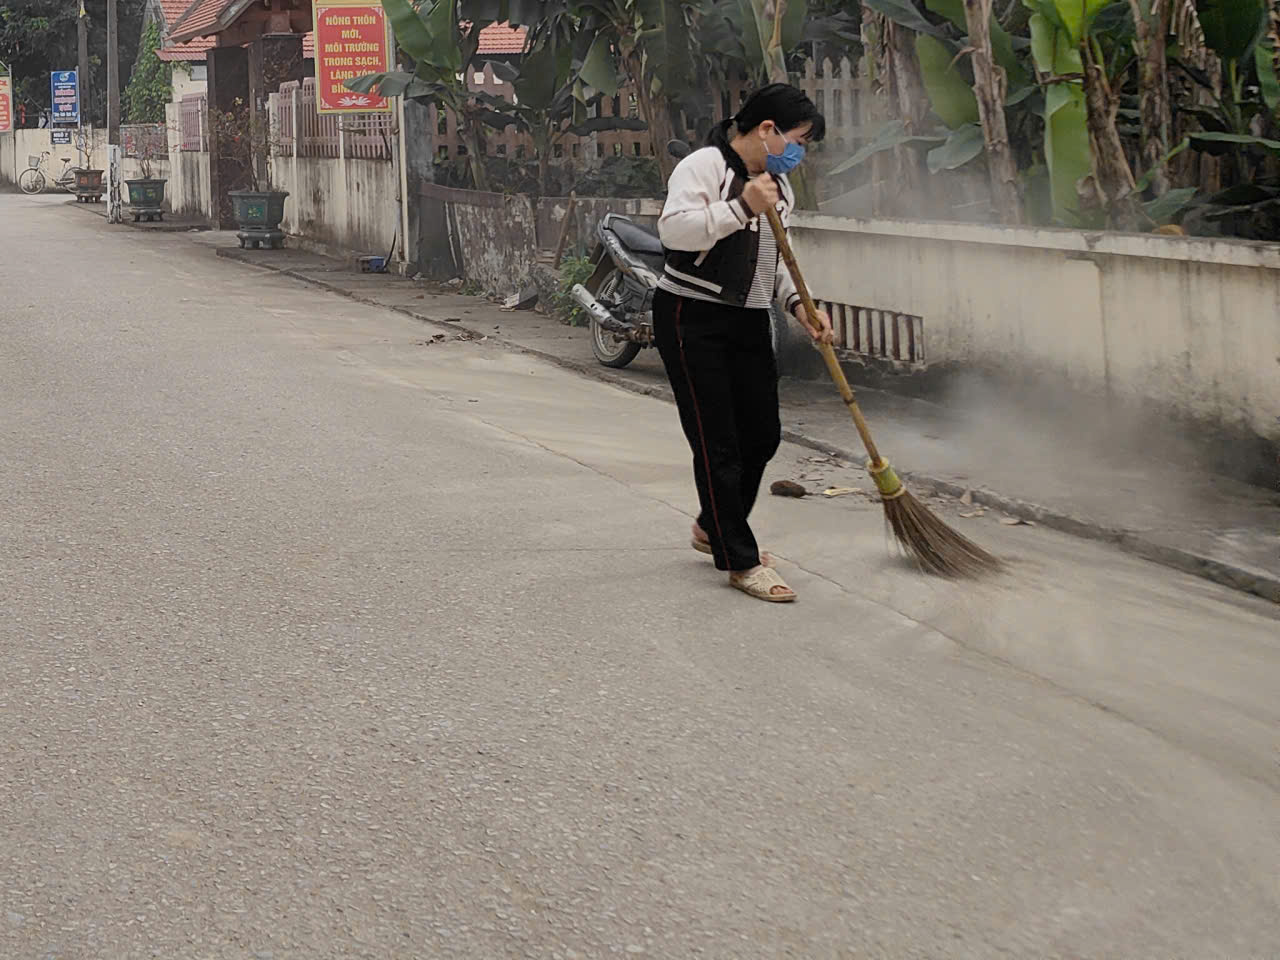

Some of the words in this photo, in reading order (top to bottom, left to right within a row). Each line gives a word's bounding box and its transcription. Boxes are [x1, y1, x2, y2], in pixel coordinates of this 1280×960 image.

[325, 14, 351, 26] NÔNG
[352, 13, 376, 25] THÔN
[325, 42, 342, 53] MÔI
[344, 41, 379, 52] TRƯỜNG
[324, 57, 353, 67] TRONG
[330, 69, 353, 80] LÀNG
